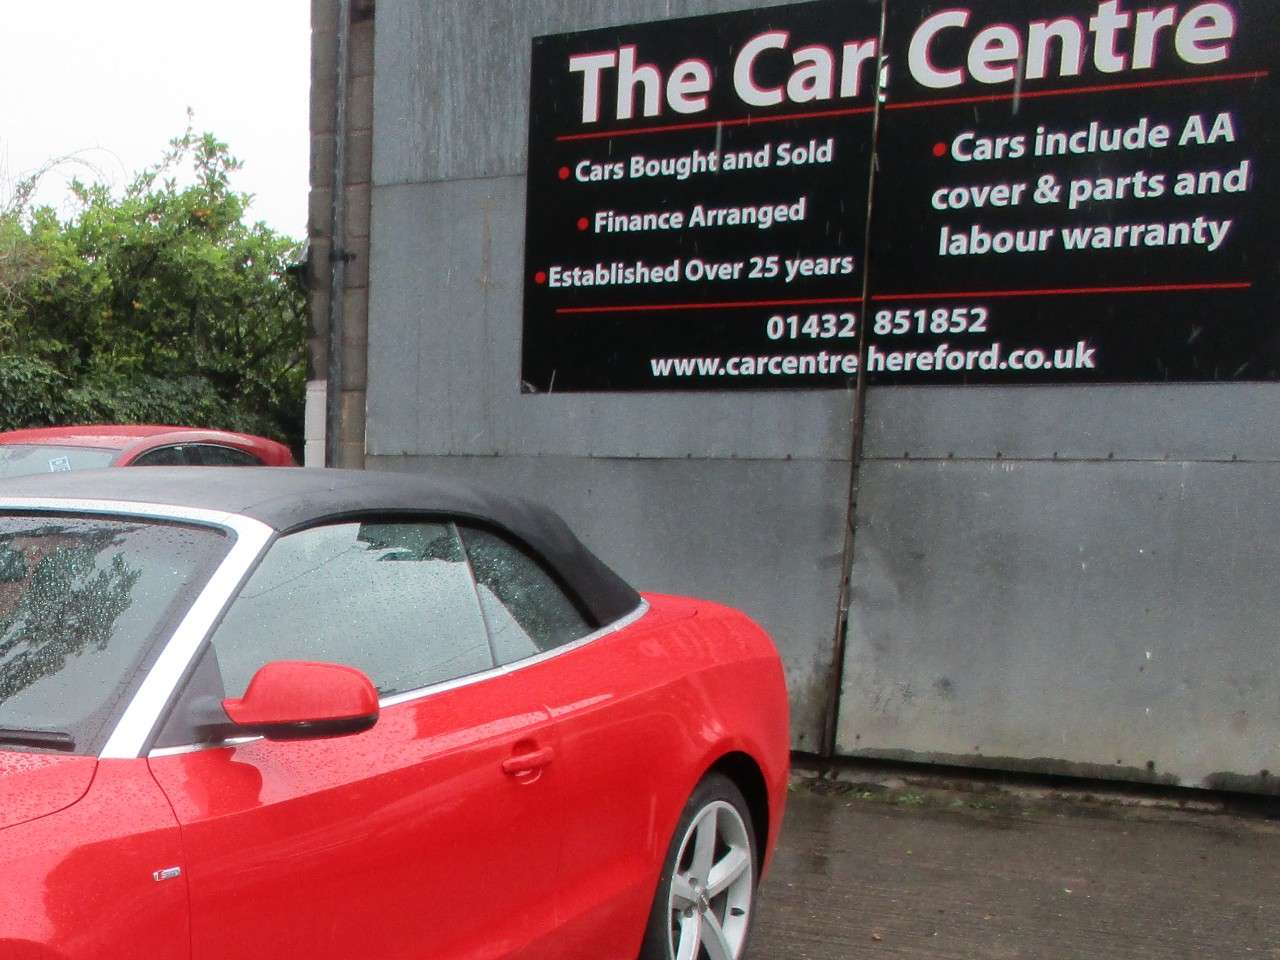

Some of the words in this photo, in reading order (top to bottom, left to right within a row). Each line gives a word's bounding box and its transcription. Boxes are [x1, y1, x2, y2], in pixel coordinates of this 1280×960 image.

[568, 45, 714, 125] The
[733, 30, 877, 107] Car
[907, 0, 1236, 90] Centre
[951, 132, 1026, 162] Cars
[1034, 117, 1170, 156] include
[1178, 112, 1235, 146] AA
[575, 160, 624, 182] Cars
[630, 149, 718, 181] Bought
[722, 143, 770, 171] and
[776, 138, 834, 166] Sold
[931, 183, 1027, 210] cover
[1033, 174, 1062, 204] &
[1068, 170, 1165, 210] parts
[1173, 159, 1250, 196] and
[594, 210, 683, 234] Finance
[688, 196, 806, 229] Arranged
[938, 224, 1054, 256] labour
[1061, 216, 1232, 252] warranty
[549, 259, 680, 287] Established
[685, 259, 744, 281] Over
[748, 255, 779, 279] 25
[784, 256, 854, 283] years
[766, 312, 856, 340] 01432
[873, 307, 988, 335] 851852
